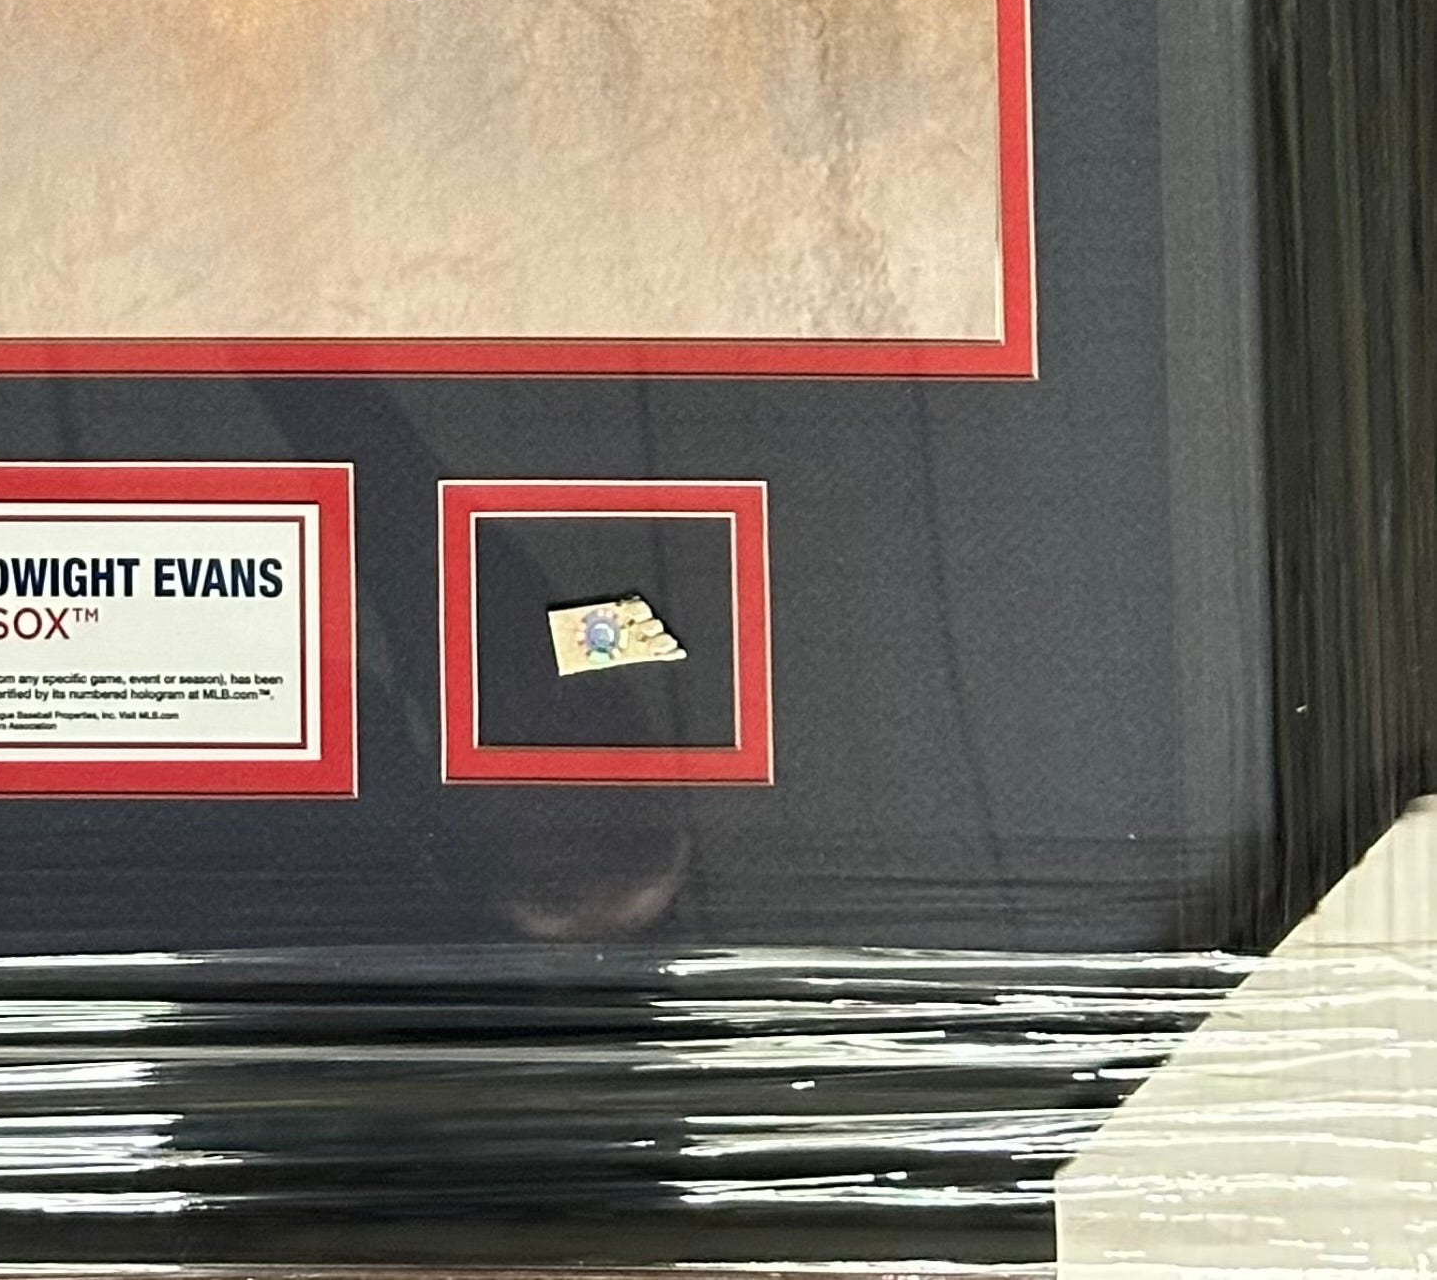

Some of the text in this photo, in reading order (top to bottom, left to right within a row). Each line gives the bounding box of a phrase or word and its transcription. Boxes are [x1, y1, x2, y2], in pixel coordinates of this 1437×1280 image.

[154, 557, 283, 598] EVANS
[17, 675, 40, 687] any
[42, 673, 88, 687] specific
[89, 675, 127, 687] game,
[128, 674, 161, 684] event
[163, 675, 177, 684] or
[178, 674, 228, 687] season),
[230, 673, 252, 684] has
[254, 674, 284, 684] been
[34, 688, 50, 702] by
[51, 688, 67, 700] its
[68, 688, 128, 700] numbered
[130, 688, 186, 702] hologram
[187, 689, 200, 700] at
